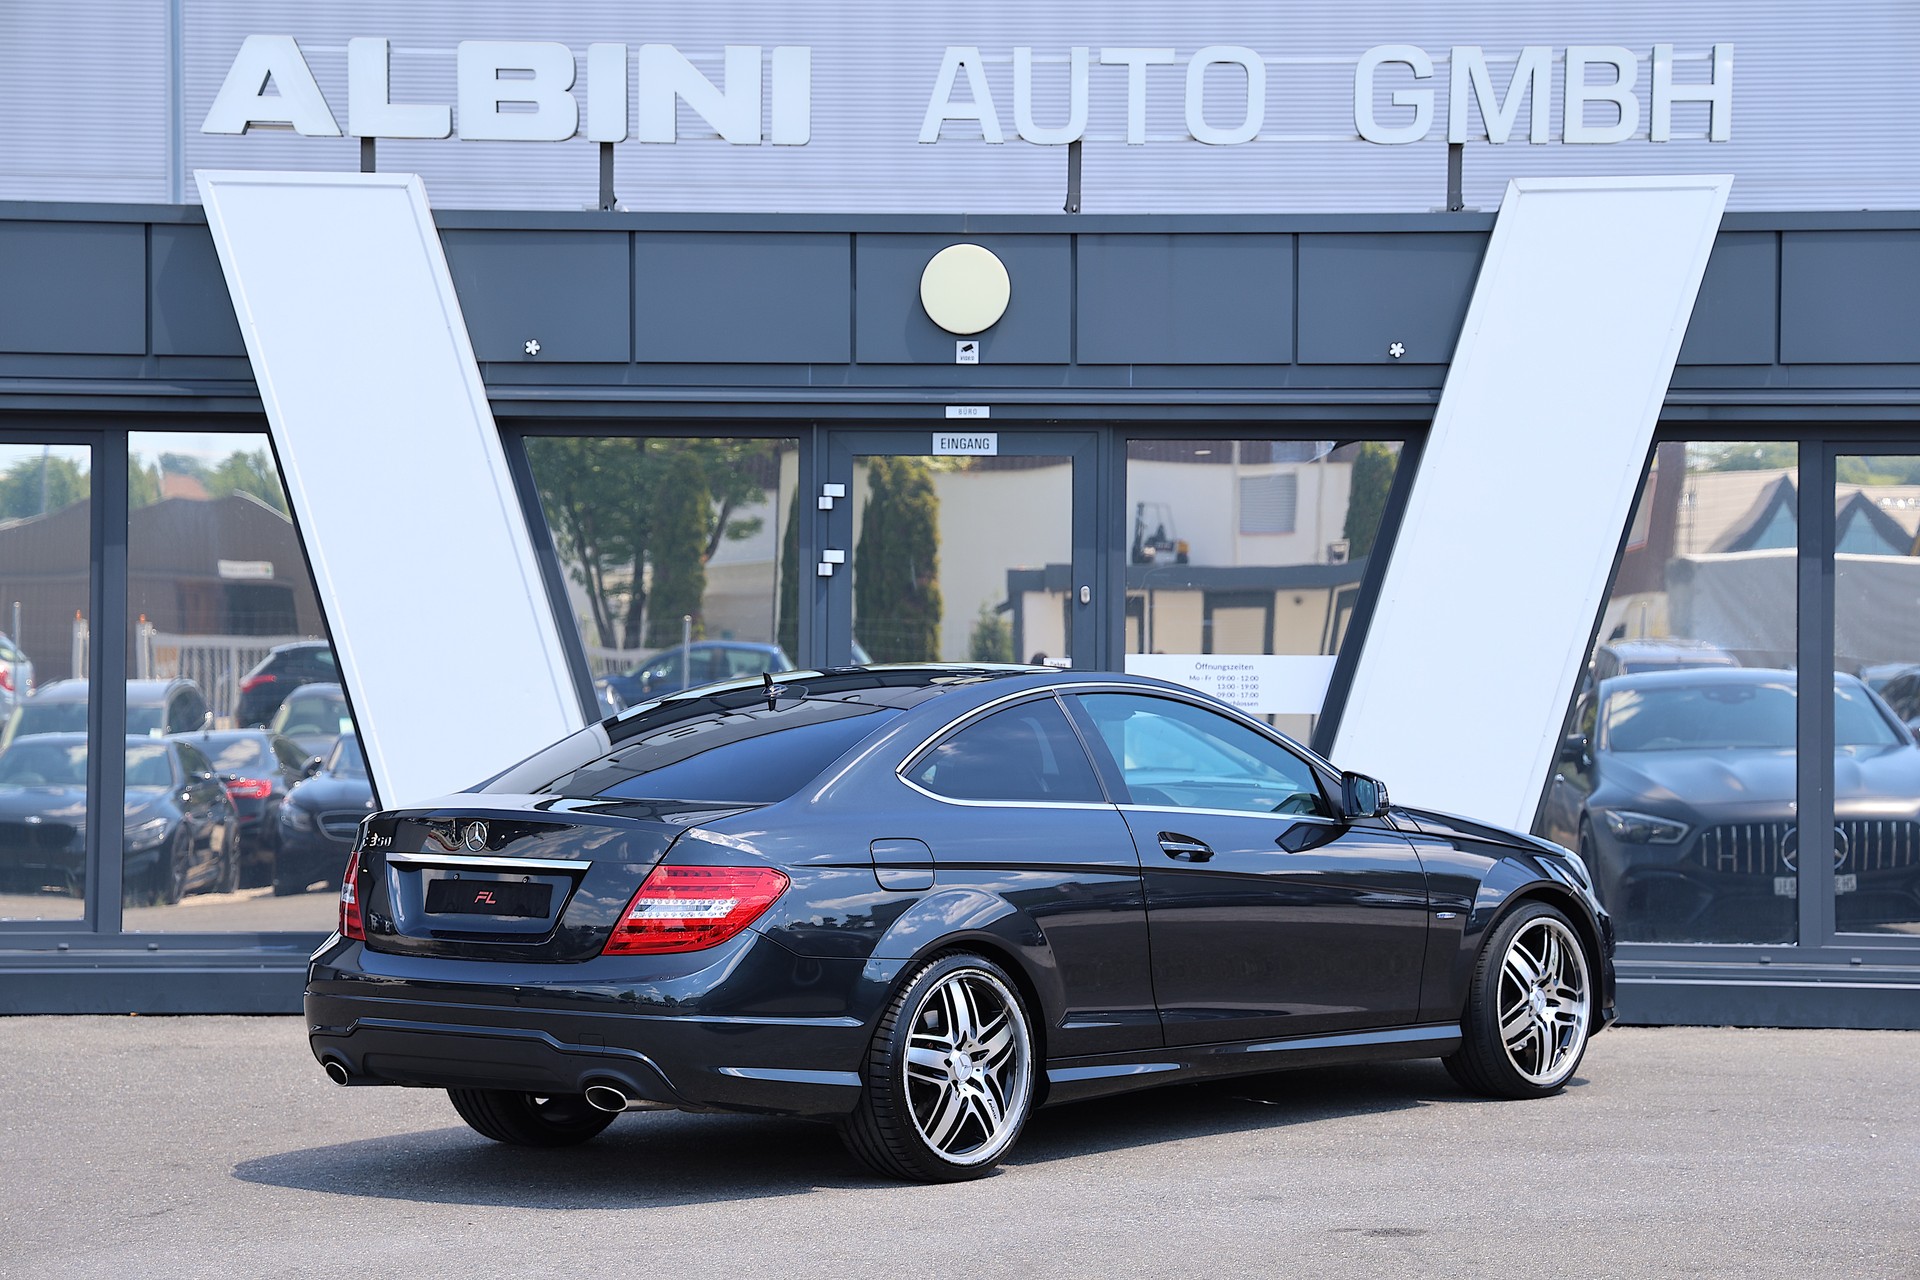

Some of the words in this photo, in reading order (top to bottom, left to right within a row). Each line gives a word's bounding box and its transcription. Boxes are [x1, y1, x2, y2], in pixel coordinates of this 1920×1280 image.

[201, 34, 811, 146] ALBINI
[917, 45, 1266, 146] AUTO
[1353, 43, 1735, 145] GMBH
[958, 406, 978, 415] BÜRO
[940, 437, 990, 450] EINGANG
[1195, 662, 1254, 671] Öffnungszeiten
[474, 891, 496, 904] FL
